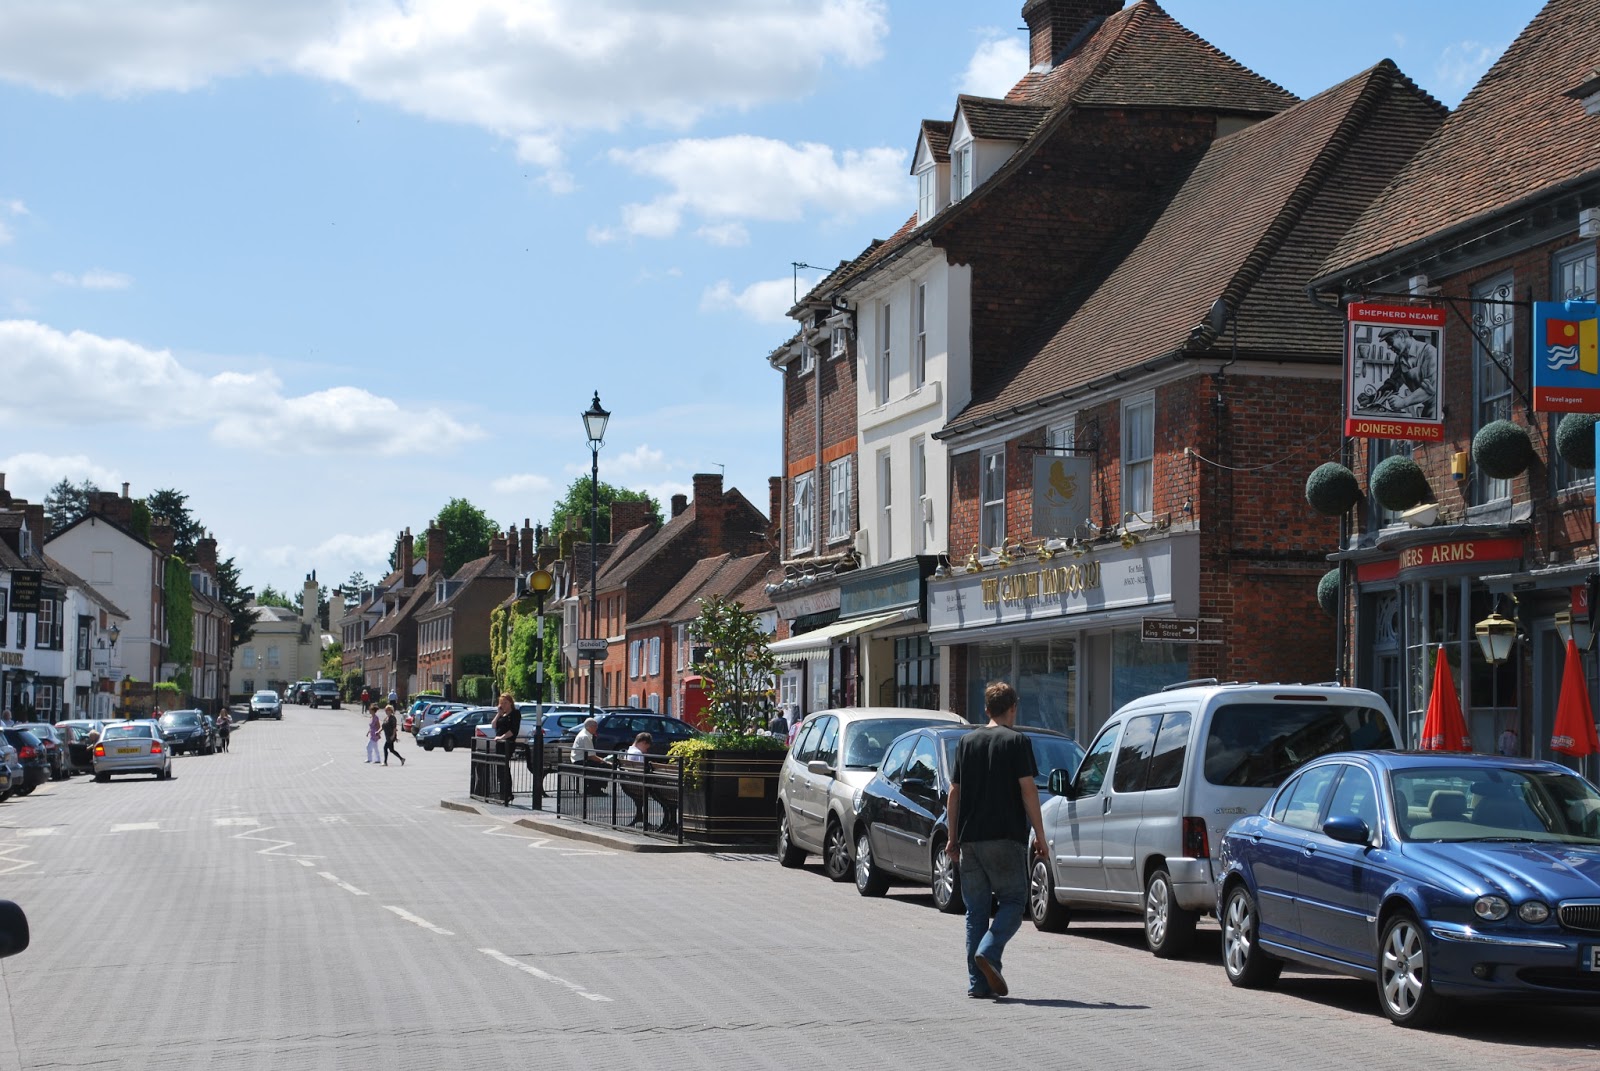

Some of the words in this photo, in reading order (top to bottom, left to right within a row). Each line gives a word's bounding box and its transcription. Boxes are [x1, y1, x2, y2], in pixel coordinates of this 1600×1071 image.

[1358, 309, 1407, 318] SHEPHERD
[1408, 312, 1439, 321] NEAME
[1545, 395, 1564, 403] Travel
[1564, 397, 1583, 405] agent
[1355, 423, 1402, 435] JOINERS
[1406, 426, 1439, 438] ARMS
[1431, 542, 1475, 563] ARMS
[981, 575, 999, 604] THE
[1001, 572, 1040, 601] GANDHI
[1041, 560, 1101, 595] TANDOORI
[1158, 622, 1178, 630] Toilets
